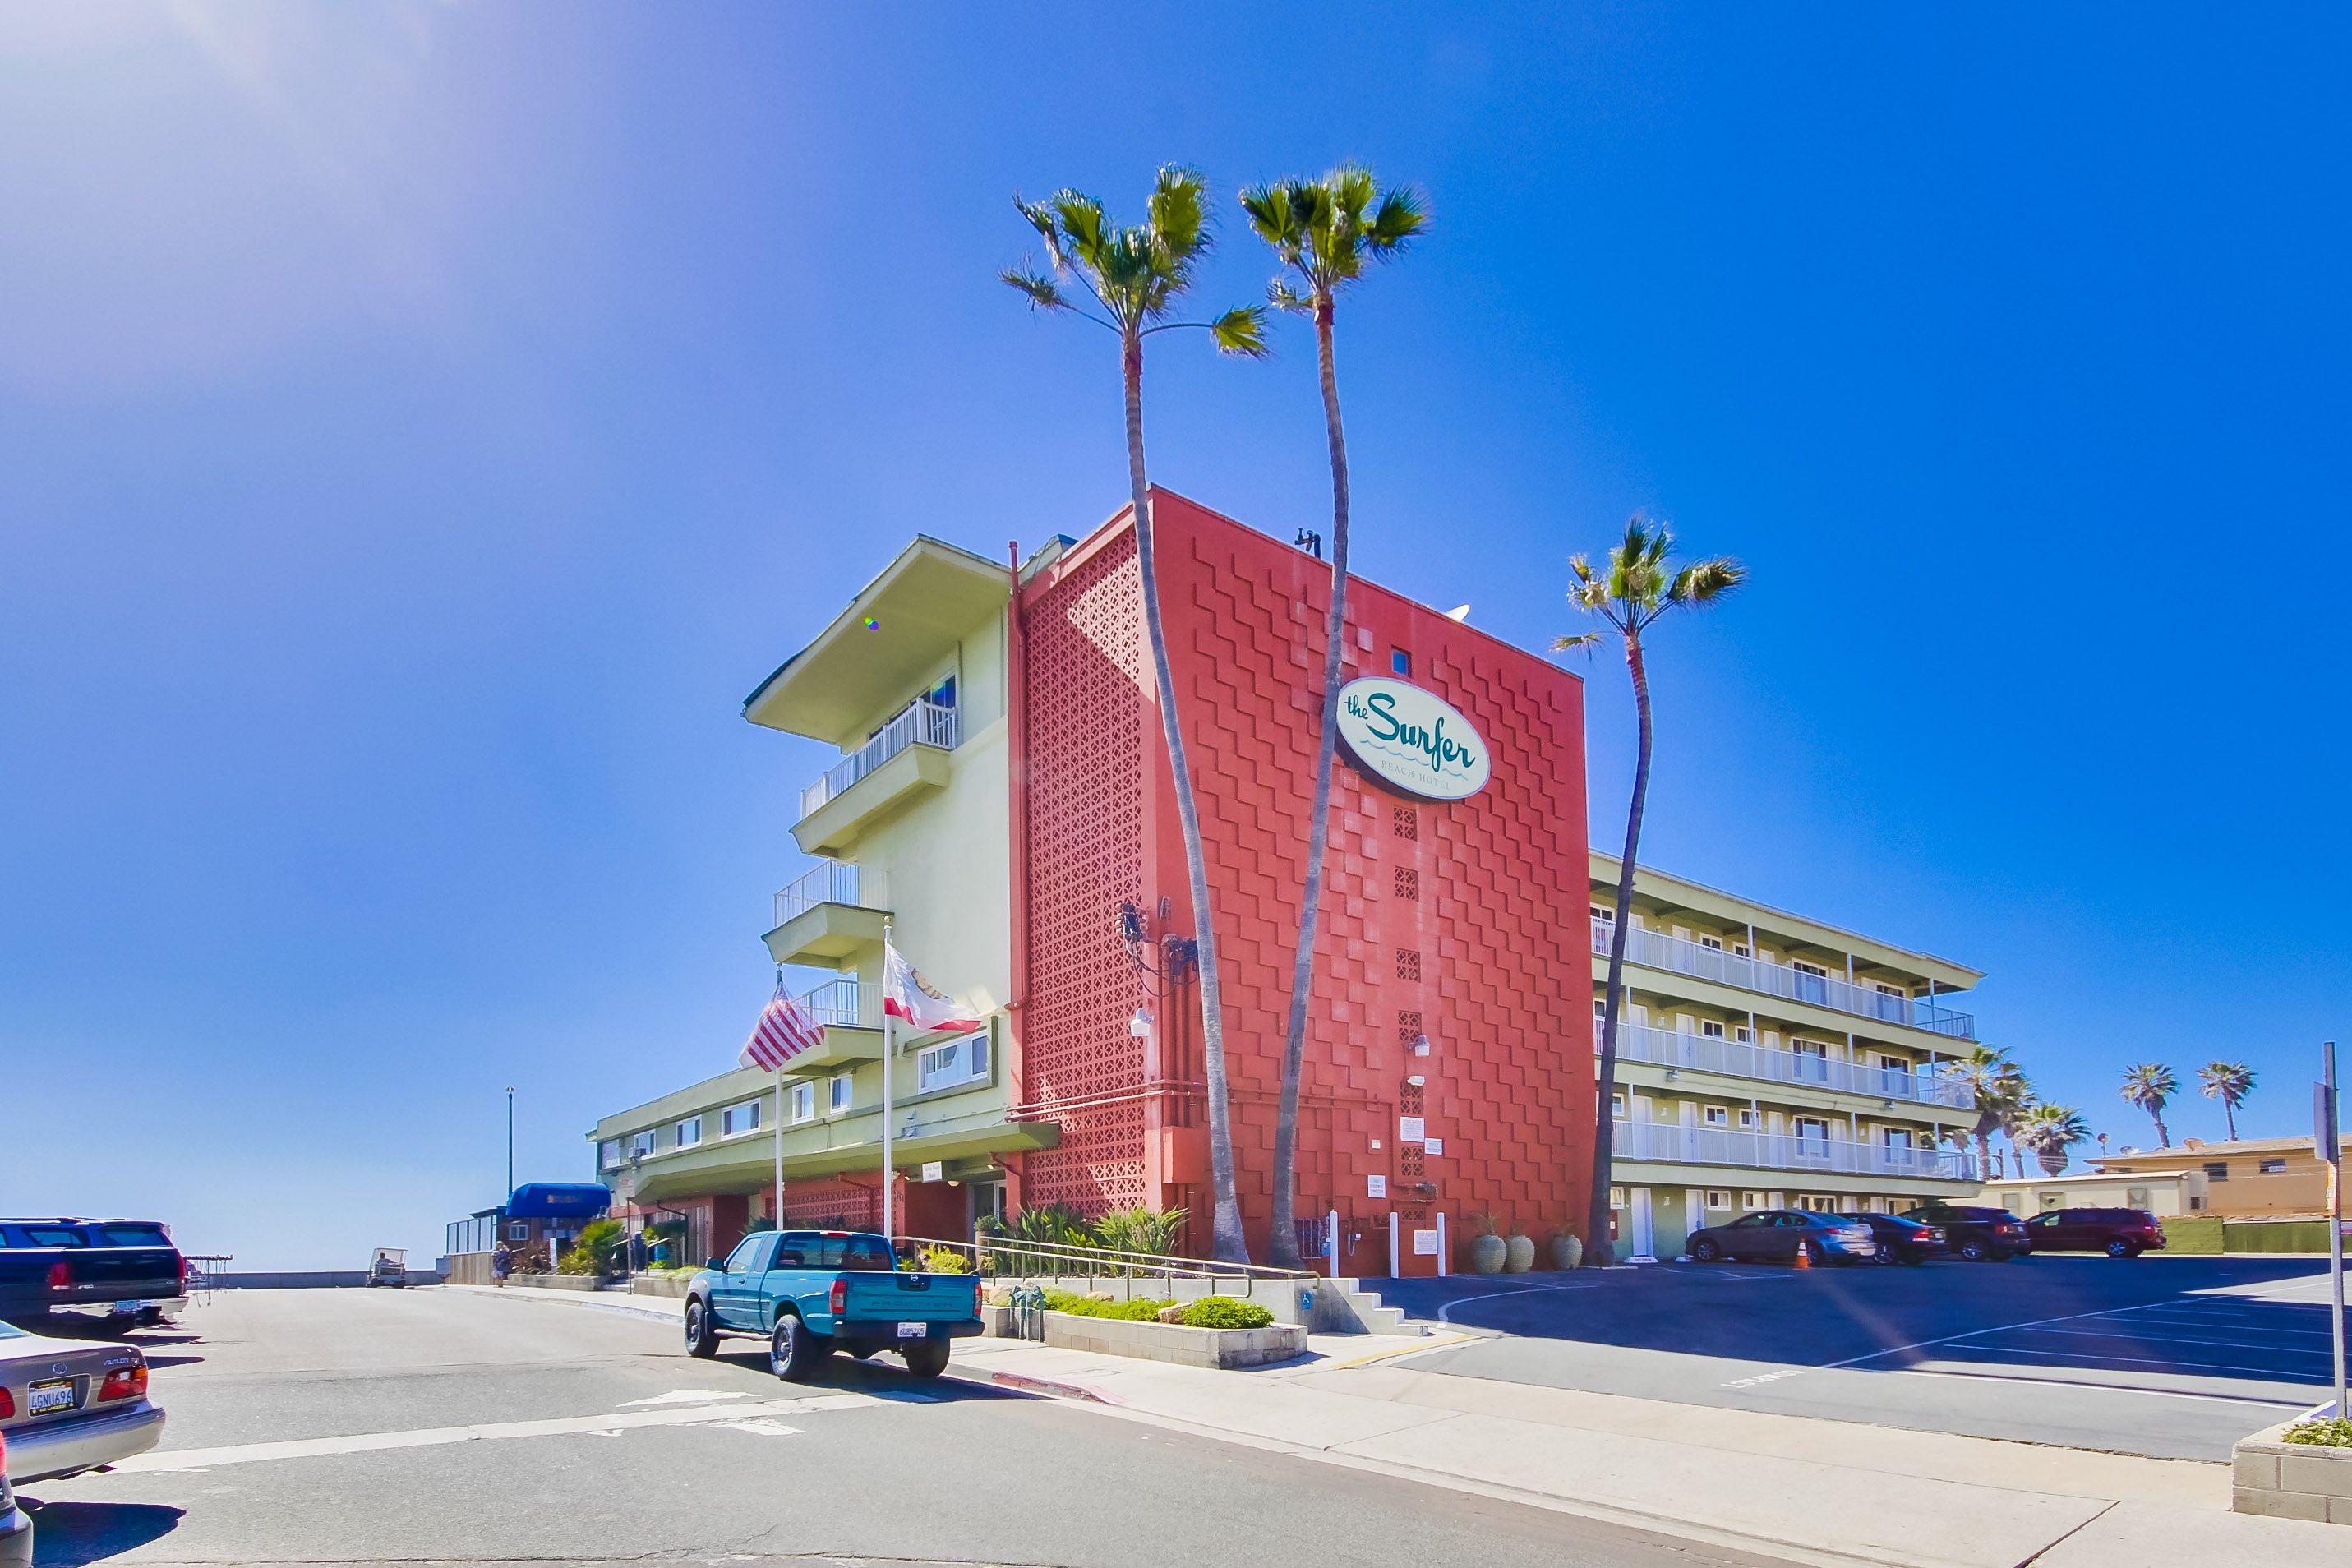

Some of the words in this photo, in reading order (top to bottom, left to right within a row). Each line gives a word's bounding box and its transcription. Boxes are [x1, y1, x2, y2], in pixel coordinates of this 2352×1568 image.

[1344, 694, 1368, 720] the
[1366, 693, 1476, 772] Surfer
[1381, 759, 1414, 778] BEACH
[1419, 773, 1451, 791] HOTEL
[31, 1390, 72, 1408] 4GNU696
